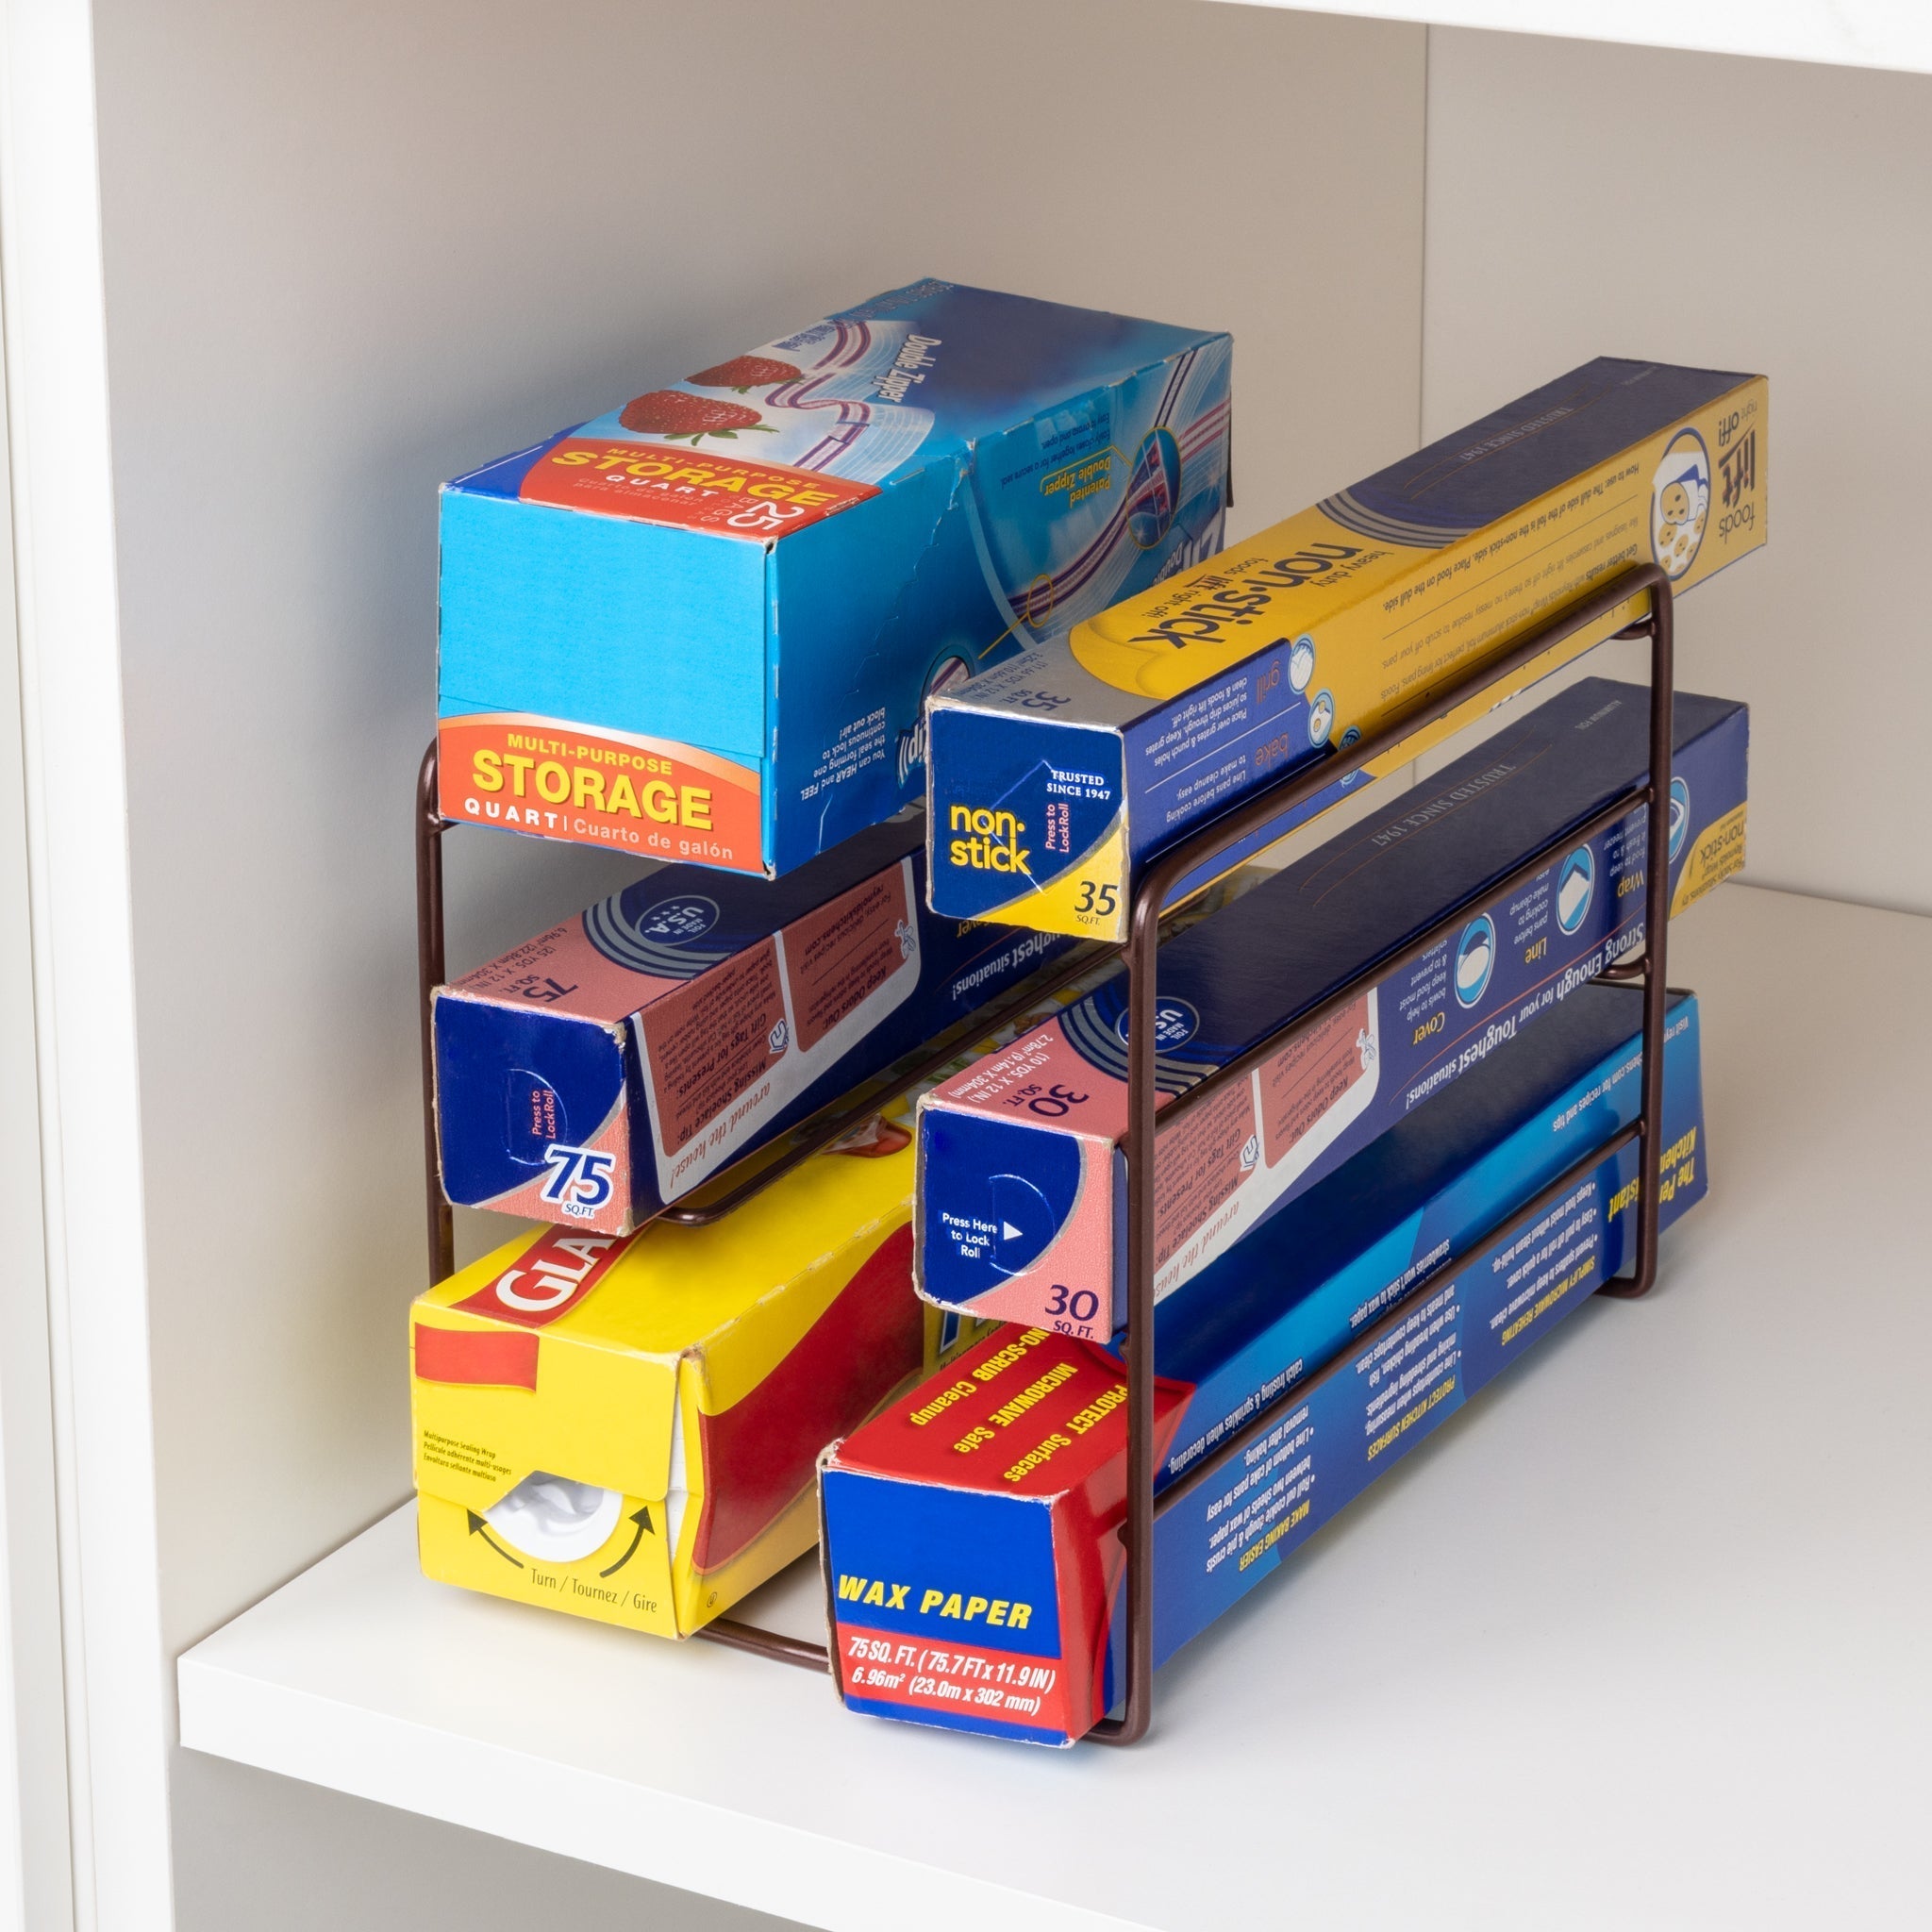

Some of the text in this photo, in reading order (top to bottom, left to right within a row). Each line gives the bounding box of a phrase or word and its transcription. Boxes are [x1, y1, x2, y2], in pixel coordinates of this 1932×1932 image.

[895, 334, 942, 369] Double
[874, 368, 925, 403] Zipper
[552, 452, 839, 507] STORAGE
[606, 475, 720, 497] QUART
[607, 448, 821, 491] MULTI-PURPOSE
[1044, 456, 1110, 497] Double Zipper
[1070, 475, 1110, 508] Patented
[727, 501, 805, 531] 25
[1719, 502, 1755, 544] foods
[1224, 557, 1268, 575] foods
[1310, 550, 1394, 587] heavy duty
[1257, 659, 1280, 703] grill
[1023, 691, 1071, 711] 35
[823, 721, 886, 760] continuous lock to
[840, 708, 886, 741] block out air!
[508, 733, 672, 775] MULTI-PURPOSE
[814, 735, 886, 778] the seal forming one
[1255, 733, 1289, 770] bake
[473, 749, 713, 831] STORAGE
[801, 749, 885, 801] You can HEAR and FEEL
[1047, 783, 1110, 800] SINCE 1947
[1051, 770, 1105, 786] TRUSTED
[1176, 755, 1245, 801] to make cleanup easy.
[1166, 770, 1245, 823] Line pans before cooking
[464, 797, 733, 860] QUART Cuarto de galón
[1045, 804, 1056, 850] Press to
[950, 837, 1032, 875] stick
[1074, 881, 1119, 916] 35
[1617, 870, 1643, 897] Wrap
[644, 908, 704, 933] U.S.A.
[1525, 937, 1547, 964] Line
[1605, 924, 1643, 963] Strong
[523, 978, 579, 1002] 75
[867, 966, 886, 989] Keep
[953, 952, 1010, 1001] situations!
[1557, 952, 1602, 1002] Enough
[841, 987, 865, 1011] Odors
[1519, 996, 1541, 1023] your
[1541, 990, 1554, 1006] for
[730, 1031, 749, 1050] Tags
[1413, 1012, 1445, 1045] Cover
[1459, 1015, 1517, 1073] Toughest
[717, 1049, 728, 1064] for
[734, 1061, 766, 1092] Missing
[1406, 1061, 1457, 1110] situations!
[532, 1091, 541, 1136] Press to
[695, 1088, 733, 1127] Shoelace
[1028, 1085, 1090, 1117] 30
[671, 1082, 770, 1189] around the house!
[542, 1145, 615, 1208] 75
[1677, 1158, 1694, 1188] The
[942, 1212, 997, 1234] Press Here
[951, 1230, 990, 1246] to Lock
[960, 1245, 980, 1258] Roll
[495, 1232, 617, 1311] GLA
[1044, 1284, 1099, 1321] 30
[1502, 1256, 1595, 1346] SIMPLIFY MICROWAVE REHEATING
[1054, 1321, 1093, 1339] SQ. FT.
[972, 1327, 1051, 1381] NO-SCRUB
[1286, 1358, 1303, 1377] catch
[1261, 1370, 1286, 1393] frosting
[909, 1380, 977, 1425] Cleanup
[954, 1362, 1078, 1453] MICROWAVE Safe
[1224, 1400, 1255, 1431] sprinkles
[1368, 1375, 1456, 1461] PROTECT KITCHEN SURFACES
[424, 1430, 495, 1458] Multipurpose Sealing Wrap
[1004, 1385, 1128, 1482] PROTECT Surfaces
[1206, 1421, 1224, 1447] when
[475, 1458, 511, 1474] multi-usages
[1168, 1436, 1206, 1474] decorating.
[473, 1469, 495, 1481] multiuso
[1239, 1499, 1309, 1571] MAKE BAKING EASIER
[531, 1568, 657, 1613] Turn Tournez Gire
[838, 1574, 1032, 1629] WAX PAPER
[895, 1646, 917, 1668] FT.
[908, 1674, 962, 1700] (23.0m
[962, 1690, 972, 1700] x
[974, 1689, 1002, 1707] 302
[1005, 1696, 1041, 1716] mm)
